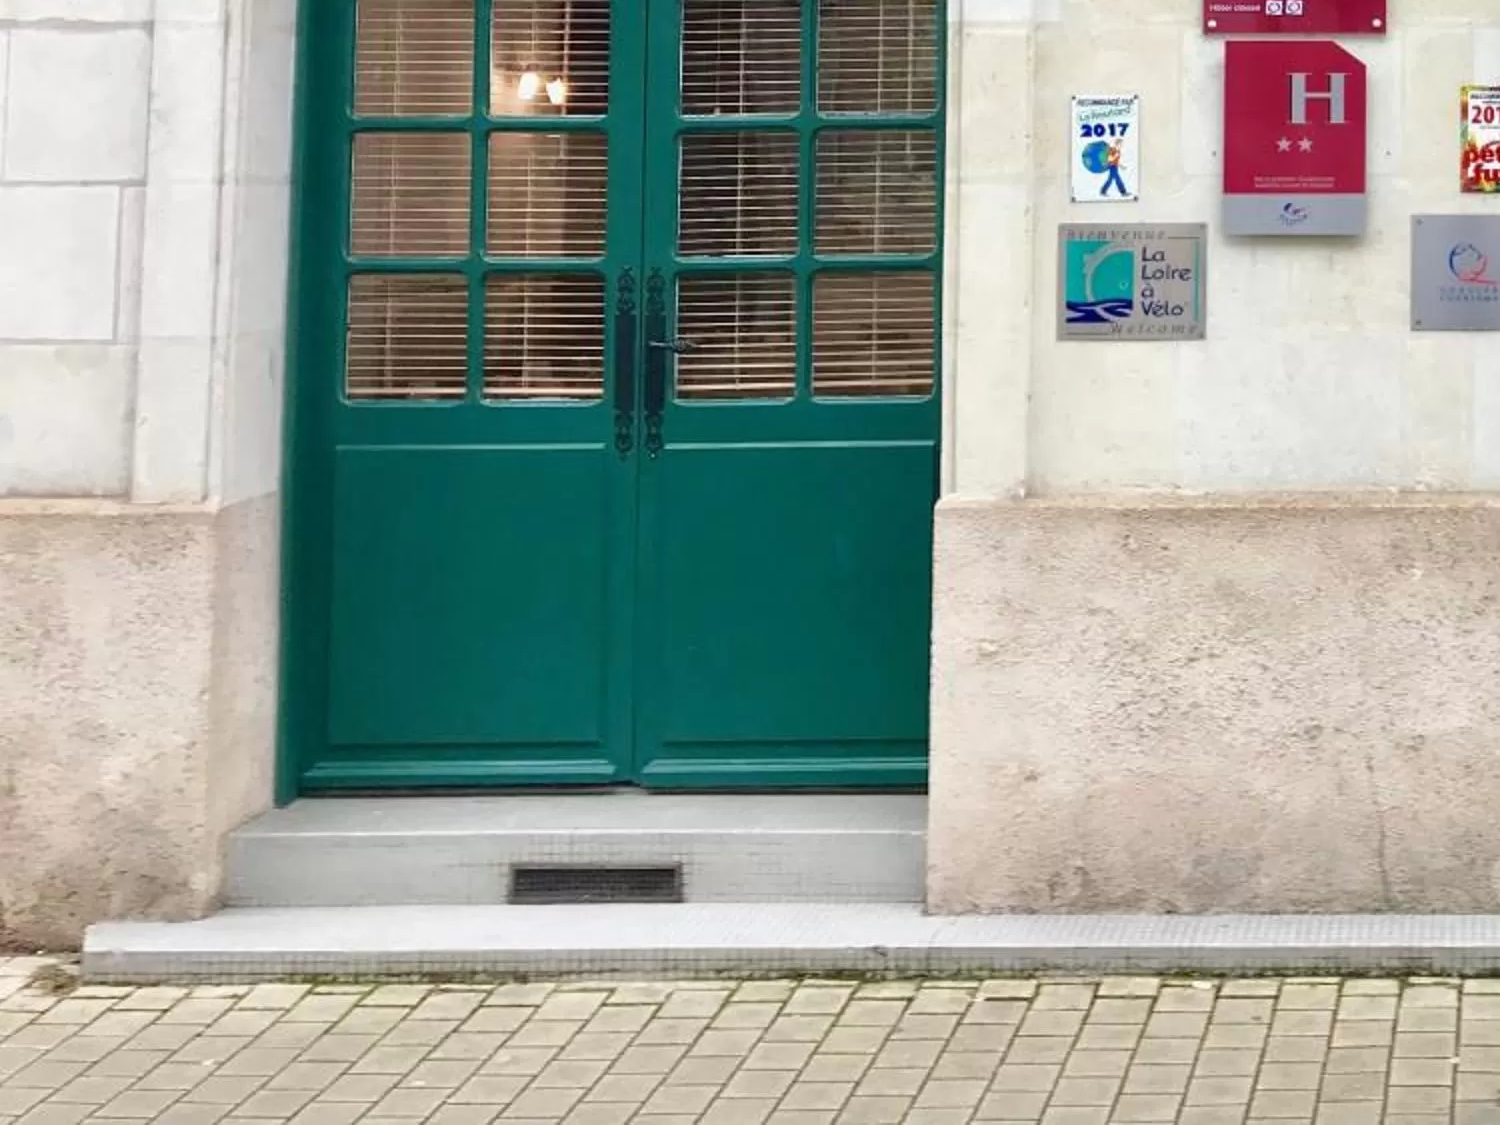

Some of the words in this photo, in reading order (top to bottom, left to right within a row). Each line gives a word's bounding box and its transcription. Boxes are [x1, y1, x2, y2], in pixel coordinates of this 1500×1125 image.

[1286, 72, 1353, 124] H
[1080, 122, 1130, 137] 2017
[1142, 246, 1165, 262] La
[1141, 264, 1192, 281] Loire
[1141, 299, 1184, 317] Vélo
